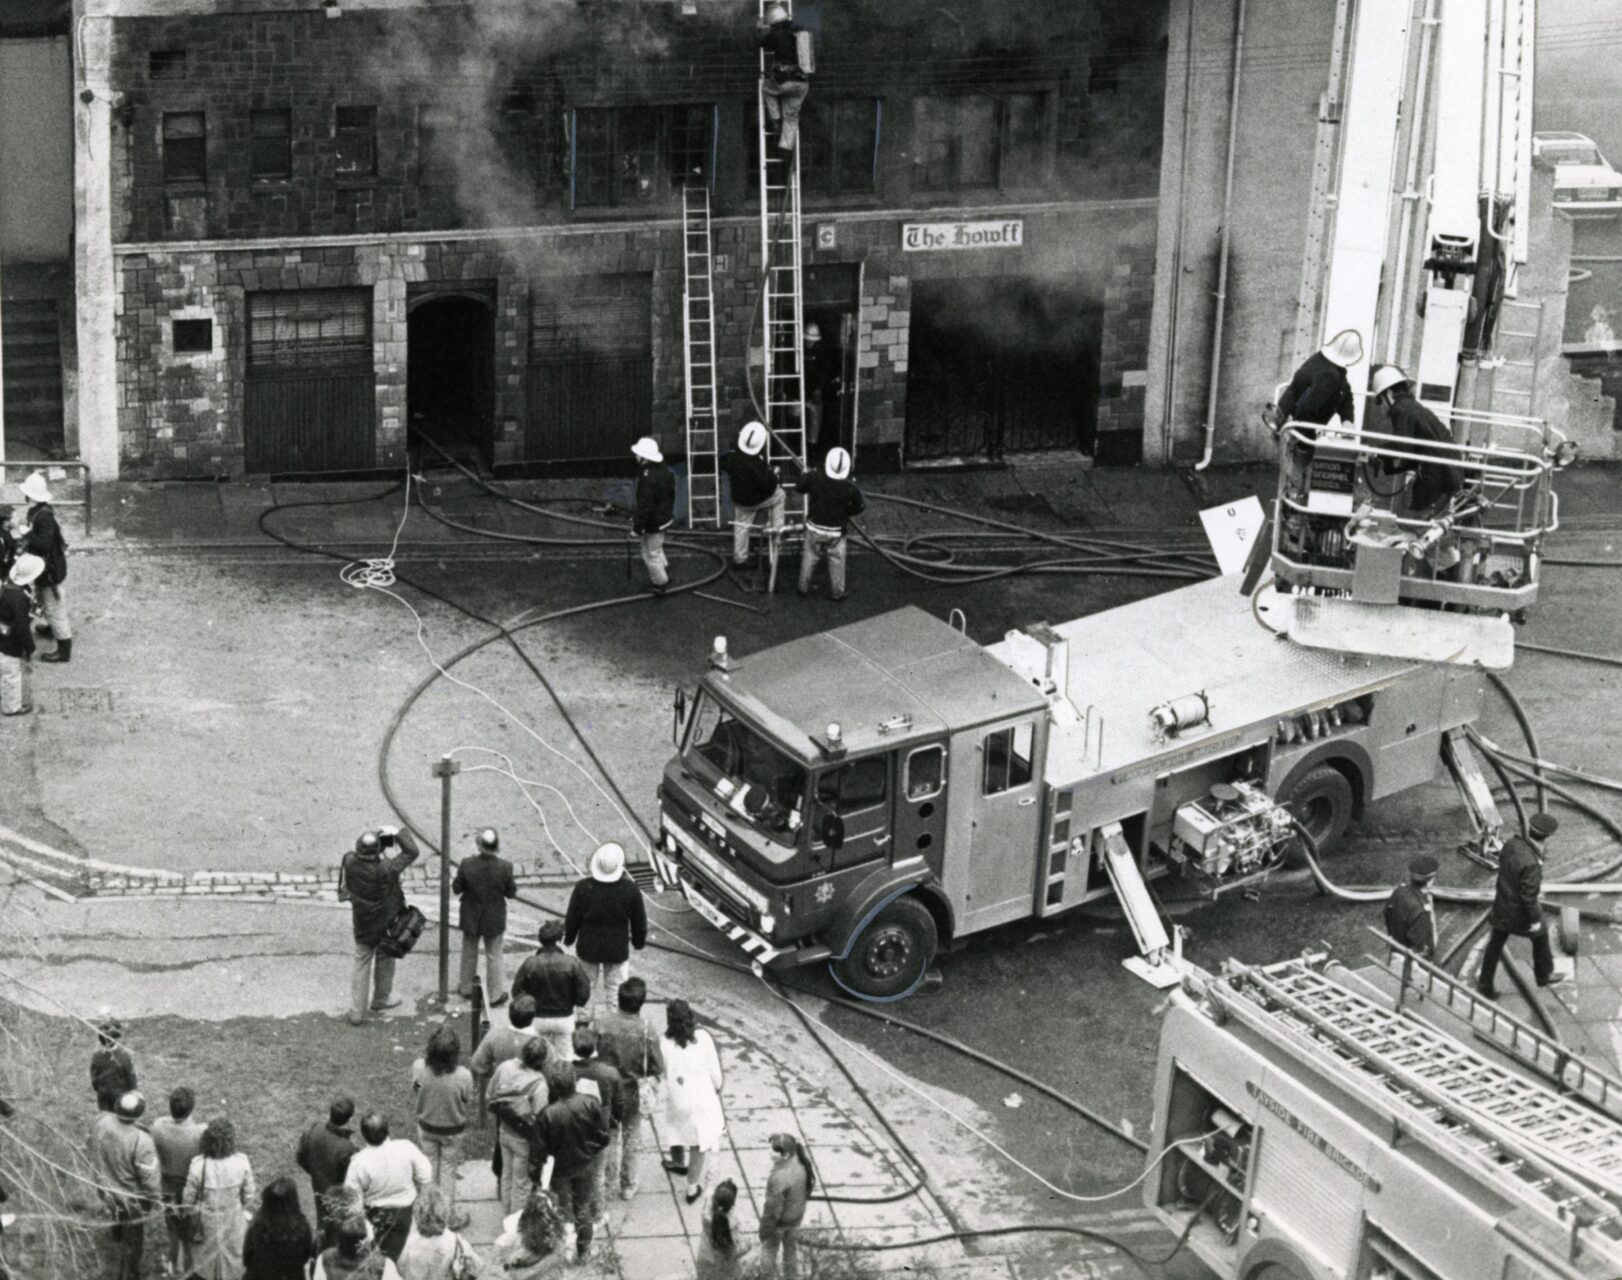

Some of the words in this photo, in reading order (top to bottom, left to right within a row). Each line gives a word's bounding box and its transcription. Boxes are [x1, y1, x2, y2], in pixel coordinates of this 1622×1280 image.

[906, 226, 946, 248] The
[951, 223, 1020, 246] Howff
[1252, 1086, 1293, 1124] TAYSIDE
[1296, 1120, 1322, 1147] FIRE
